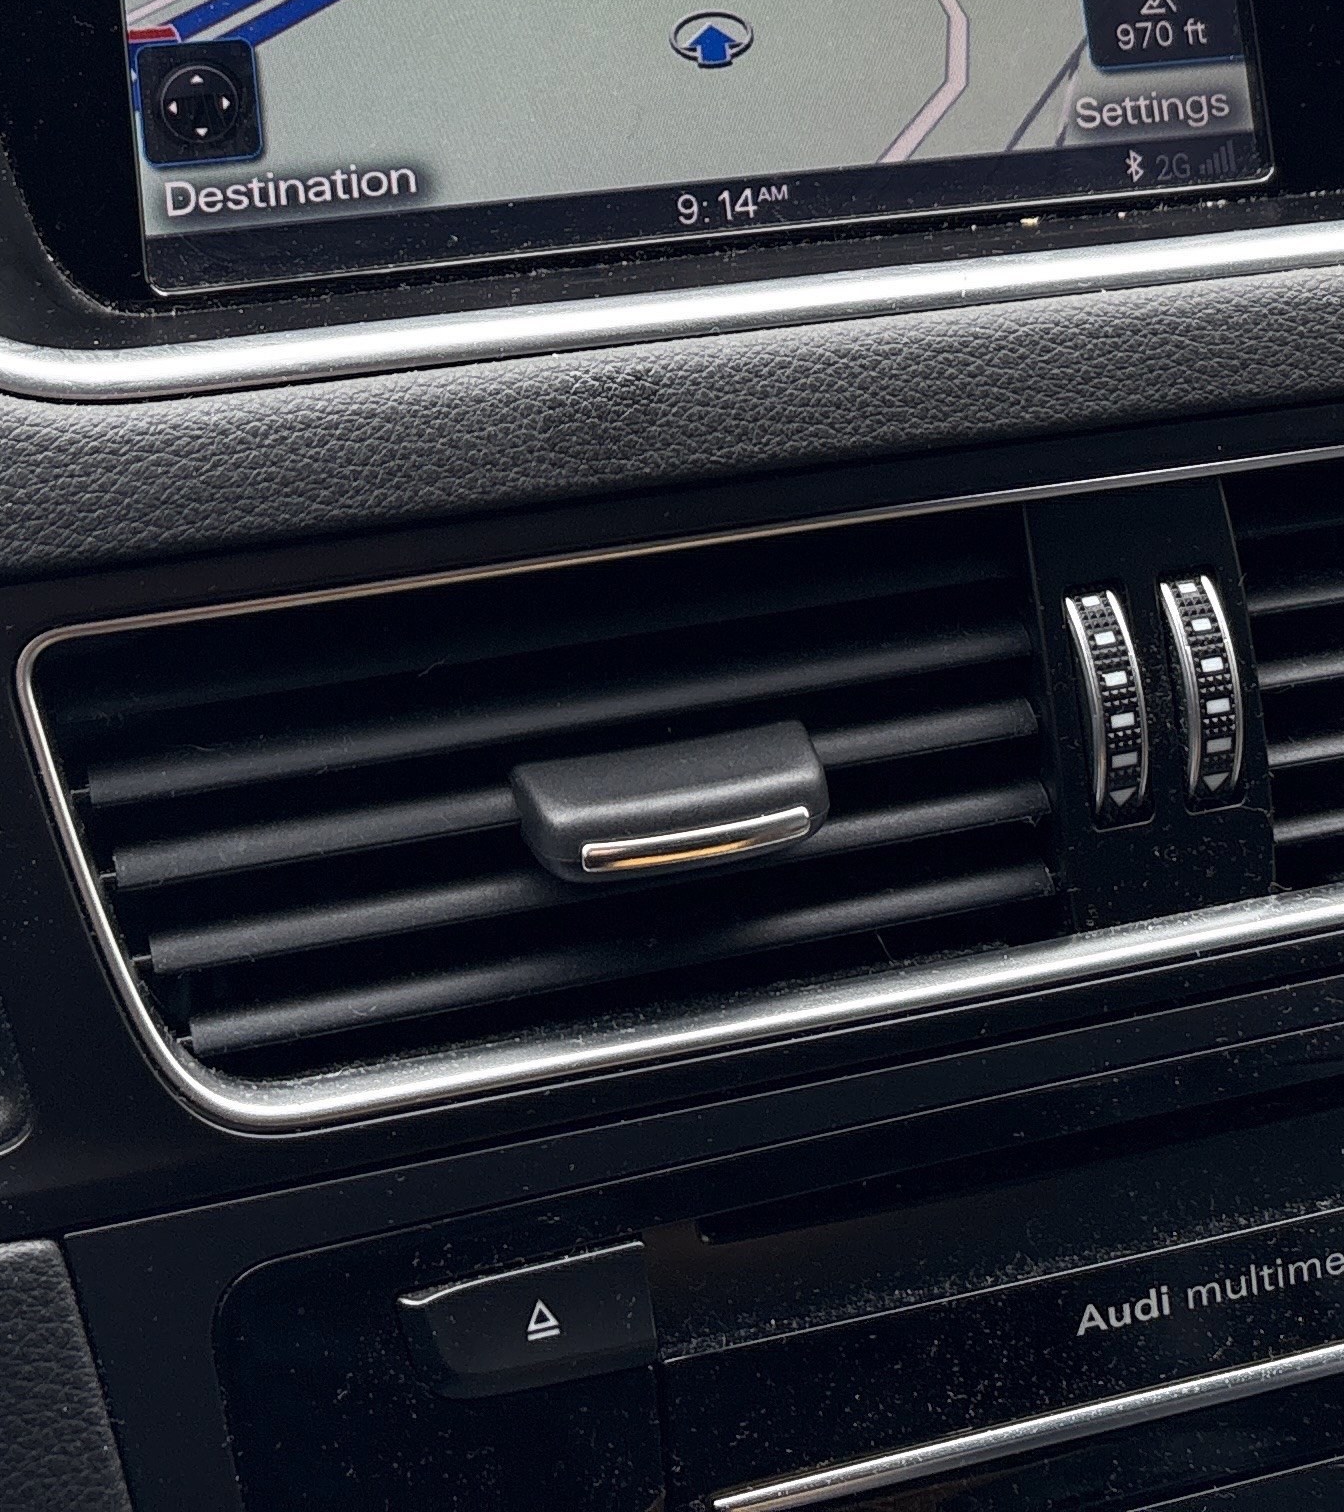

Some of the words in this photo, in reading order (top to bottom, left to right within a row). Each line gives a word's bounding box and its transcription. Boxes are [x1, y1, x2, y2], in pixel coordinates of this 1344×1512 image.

[1115, 19, 1174, 51] 970
[1183, 18, 1208, 46] ft
[1074, 90, 1230, 130] Settings
[1156, 152, 1192, 181] 2G
[163, 163, 418, 220] Destination
[1075, 1285, 1171, 1337] Audi
